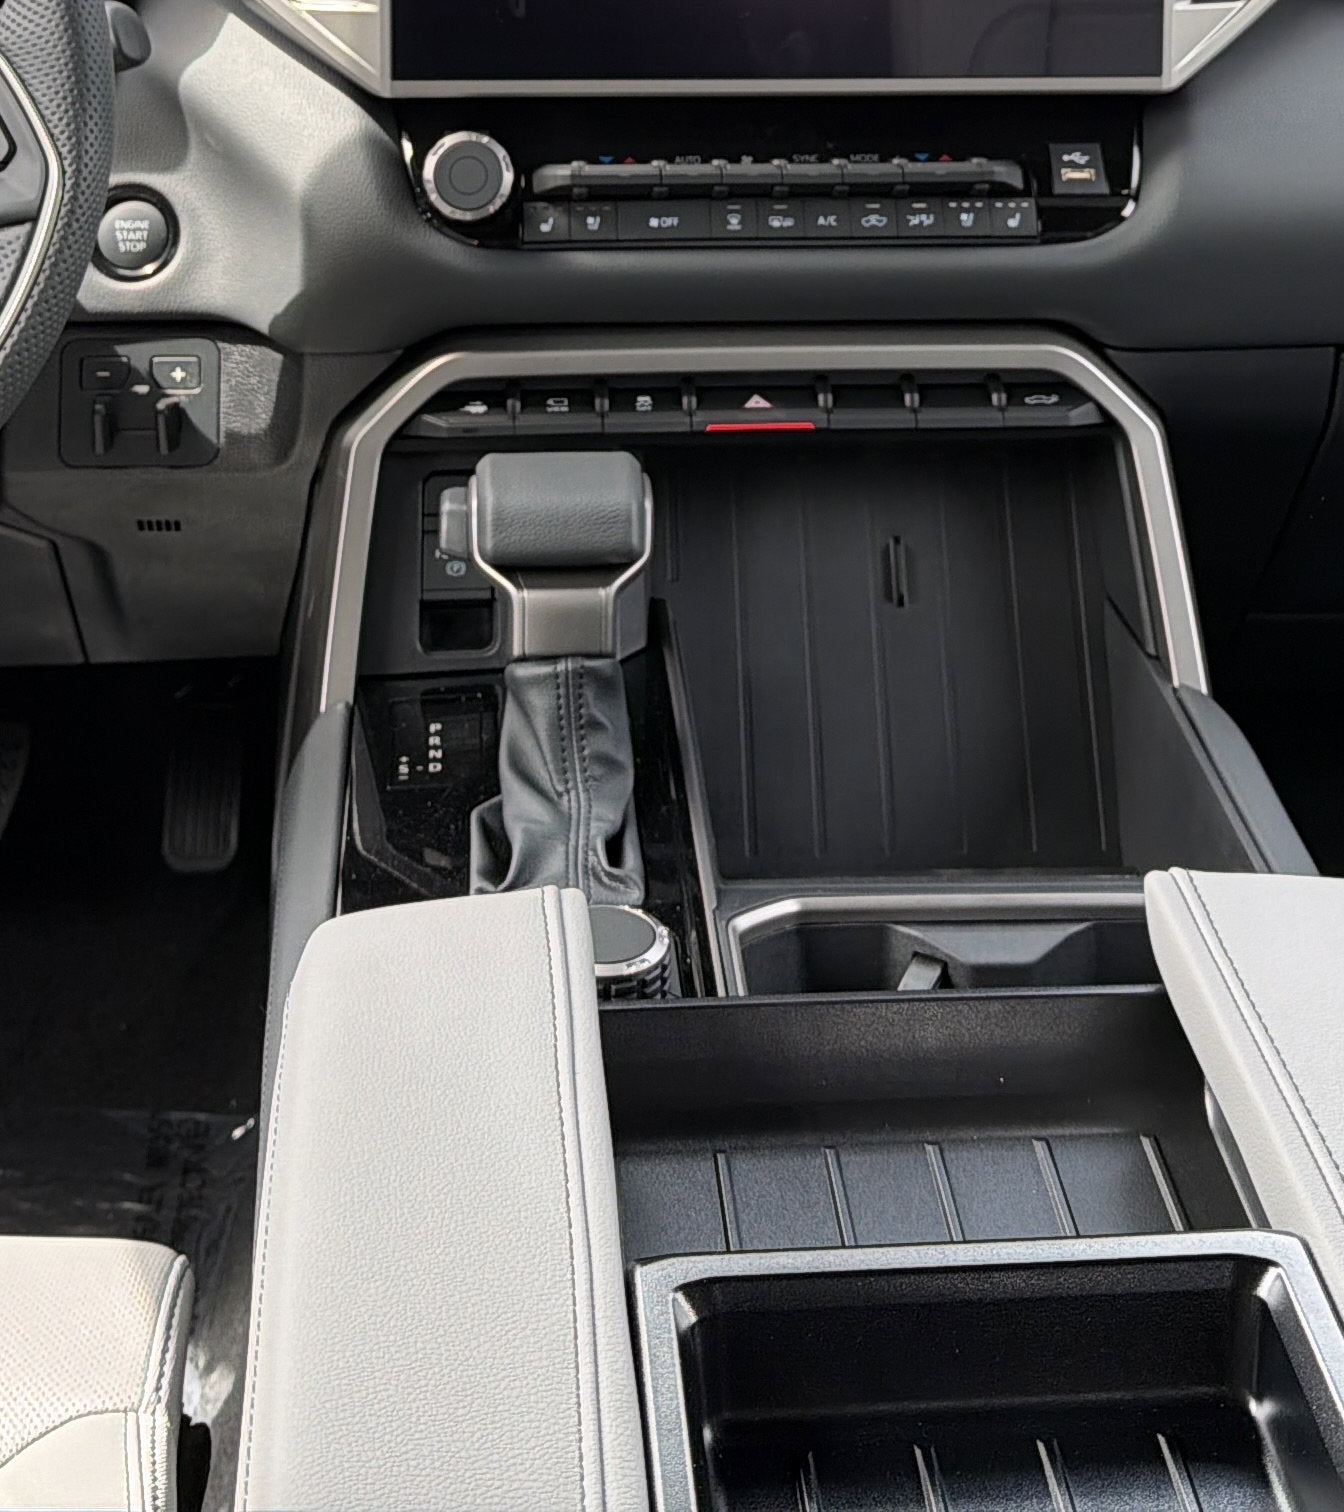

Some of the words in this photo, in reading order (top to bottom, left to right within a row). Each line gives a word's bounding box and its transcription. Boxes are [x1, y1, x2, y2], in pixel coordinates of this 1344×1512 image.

[674, 156, 702, 164] AUTO
[792, 154, 819, 163] SYNC
[850, 154, 880, 162] MODE
[114, 220, 150, 230] ENGINE
[660, 216, 679, 228] OFF
[817, 216, 838, 226] A/C
[115, 230, 148, 240] START
[118, 241, 146, 252] STOP
[429, 722, 442, 734] P
[428, 736, 441, 746] R
[428, 749, 442, 759] N
[428, 762, 442, 772] D
